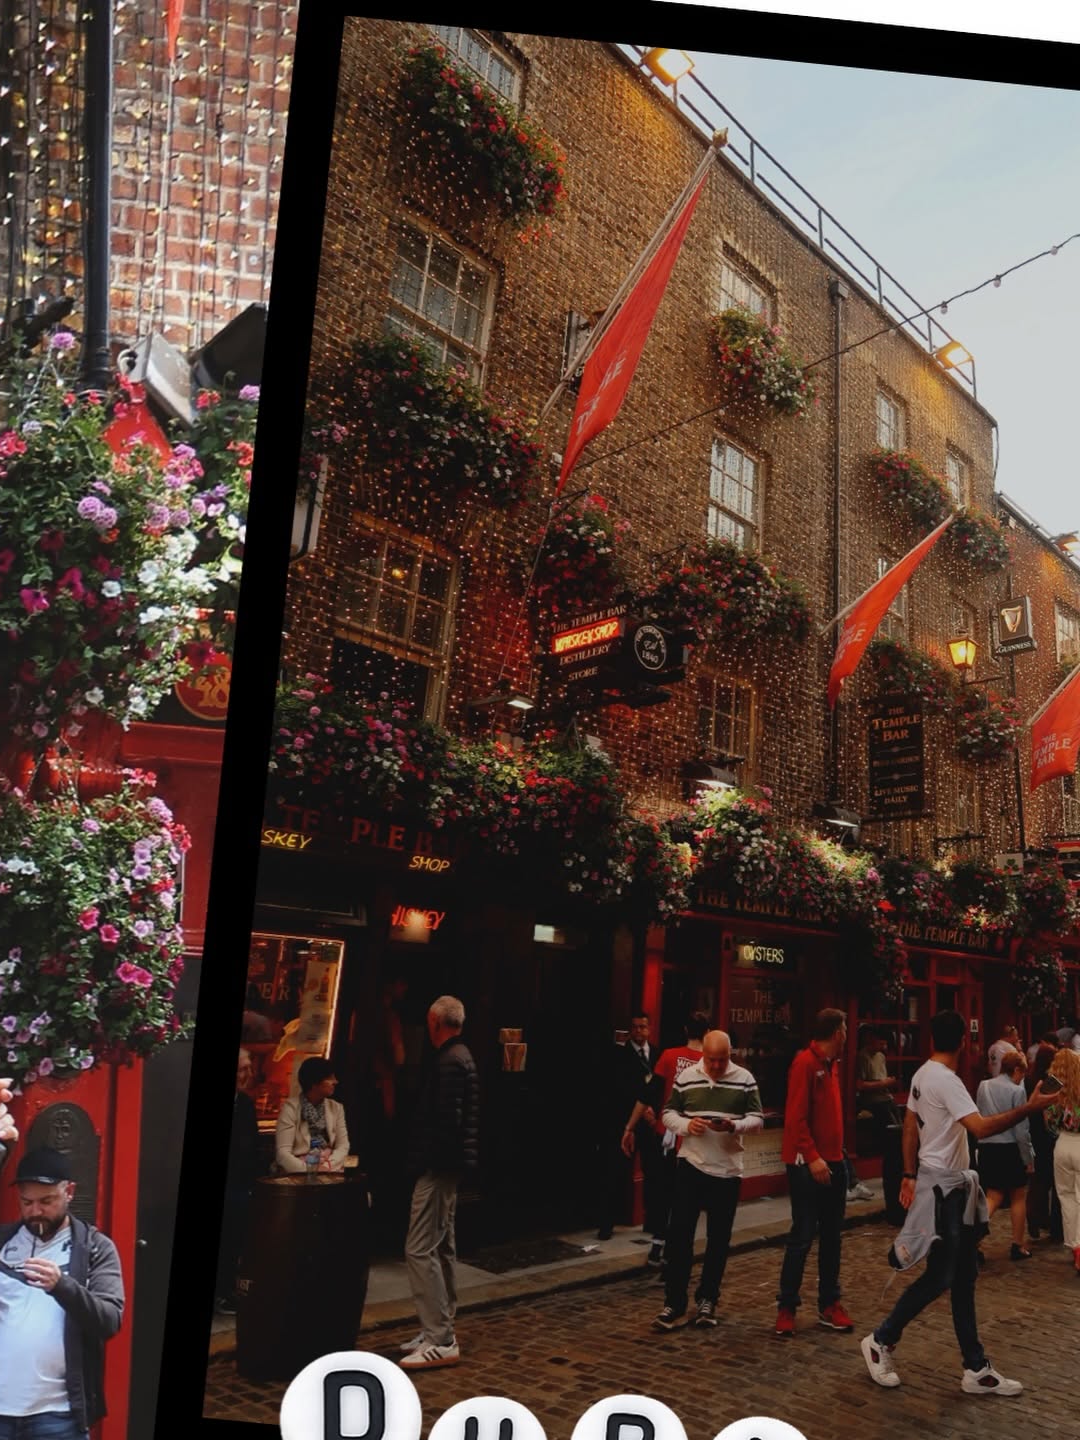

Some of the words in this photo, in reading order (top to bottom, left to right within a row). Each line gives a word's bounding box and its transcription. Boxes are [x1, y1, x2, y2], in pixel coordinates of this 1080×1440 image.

[568, 666, 599, 681] STORE
[871, 713, 921, 730] TEMPLE
[881, 729, 910, 741] BAR
[408, 855, 451, 873] SHOP
[743, 944, 785, 965] OYSTERS
[729, 1008, 773, 1024] TEMPLE
